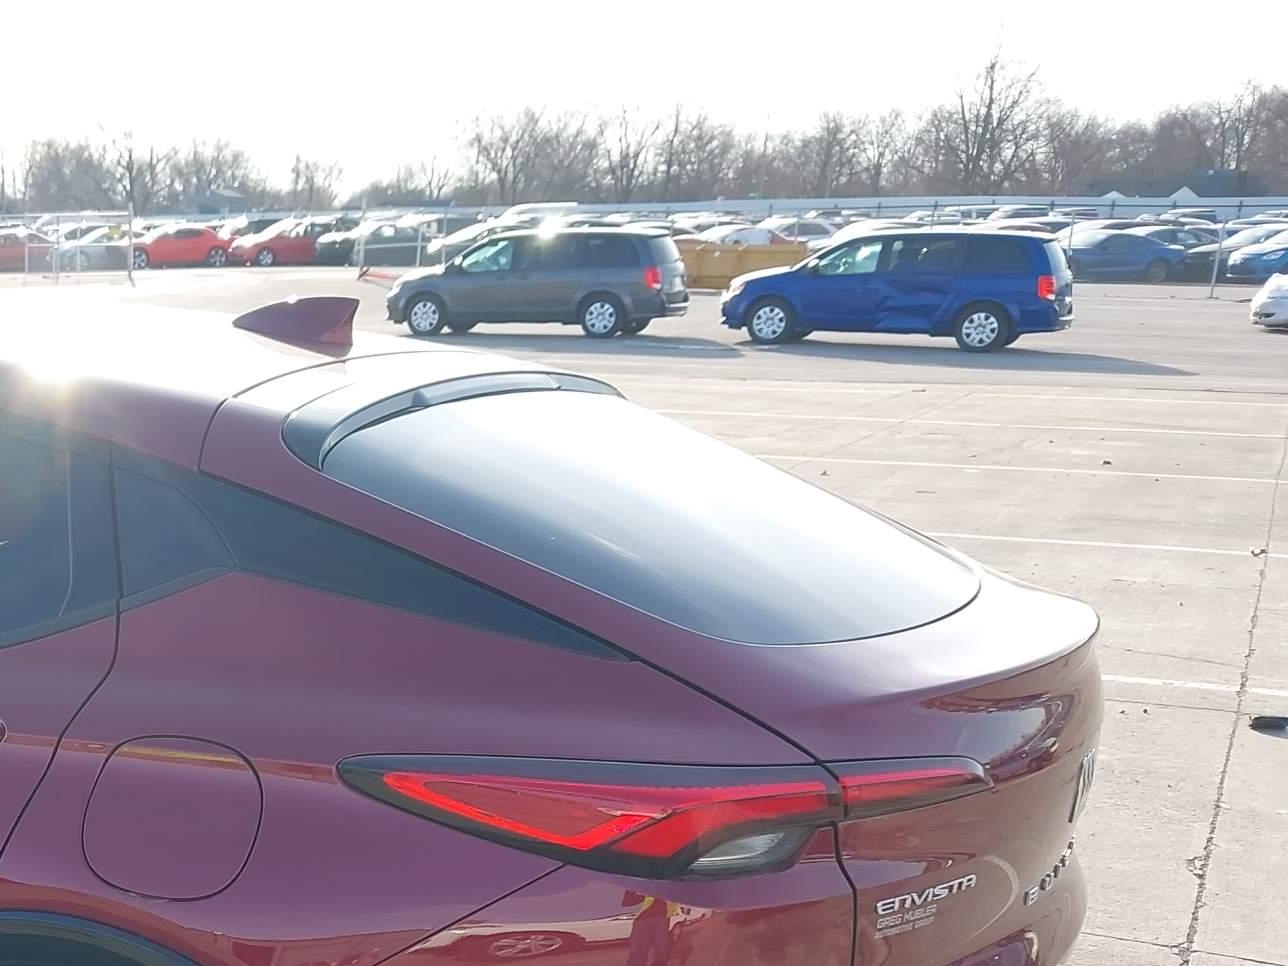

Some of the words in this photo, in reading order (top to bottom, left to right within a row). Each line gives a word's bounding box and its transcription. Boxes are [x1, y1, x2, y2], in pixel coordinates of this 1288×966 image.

[1022, 834, 1076, 907] BUI
[875, 873, 978, 917] ENVISTA
[876, 914, 903, 930] GREG
